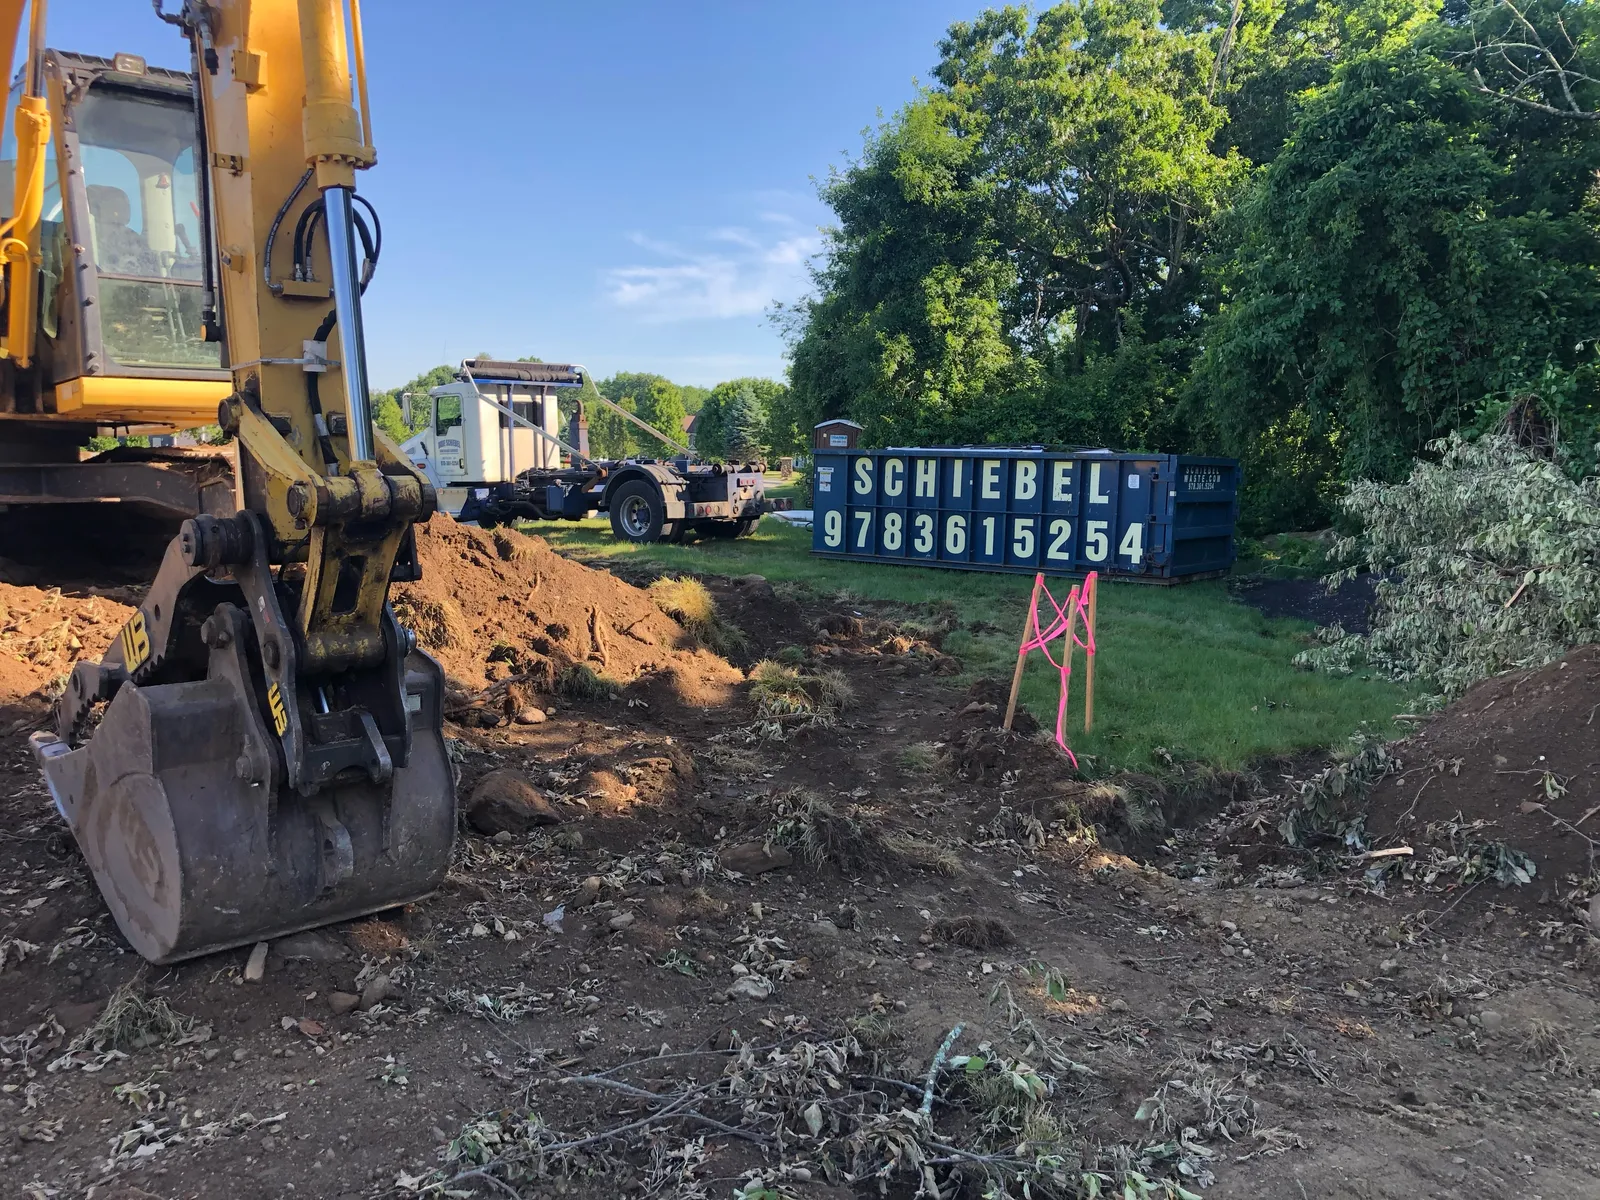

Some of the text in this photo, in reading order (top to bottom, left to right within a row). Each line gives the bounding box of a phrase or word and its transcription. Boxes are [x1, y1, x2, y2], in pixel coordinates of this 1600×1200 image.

[1185, 466, 1220, 475] SCHIEBEL
[854, 457, 1109, 504] SCHIEBEL
[1183, 474, 1221, 483] WASTE.COM
